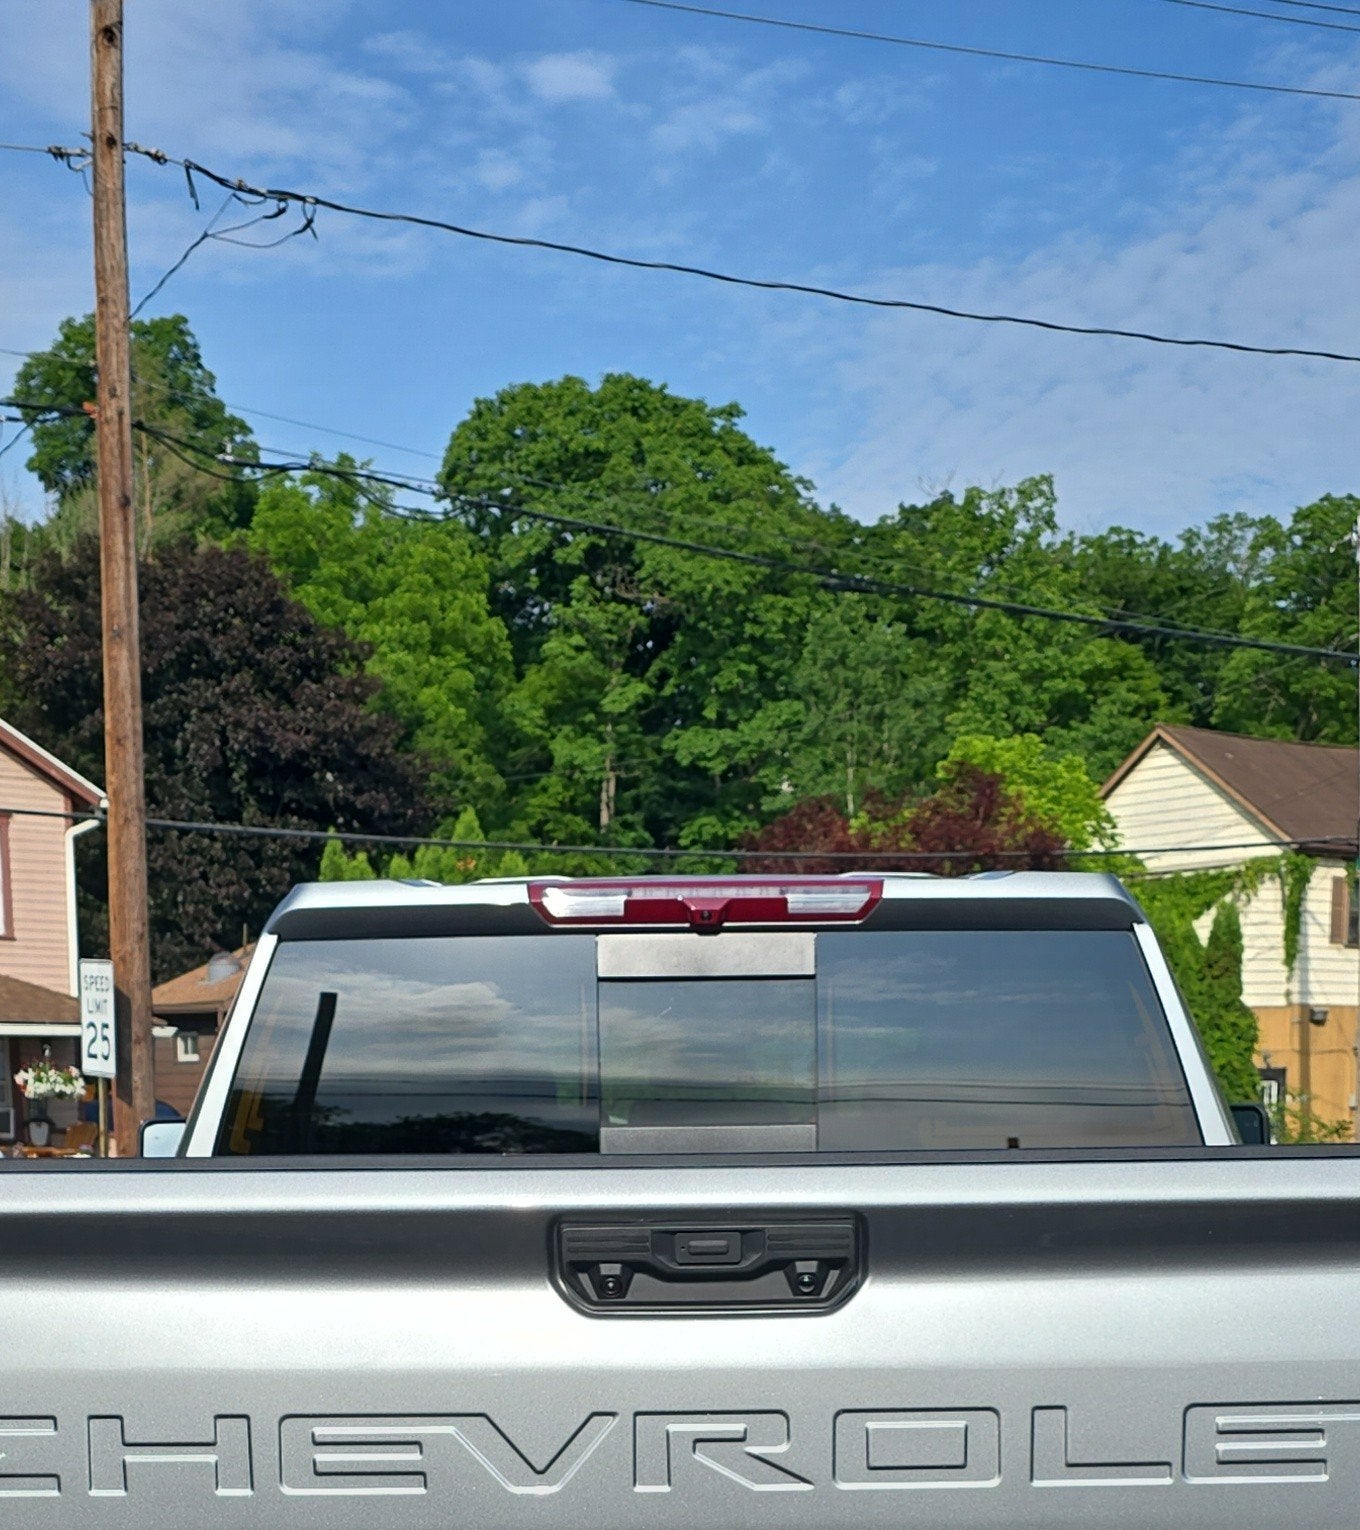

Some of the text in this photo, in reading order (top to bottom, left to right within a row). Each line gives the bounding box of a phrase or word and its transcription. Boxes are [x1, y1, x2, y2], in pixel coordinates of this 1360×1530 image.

[83, 974, 110, 993] SPEED
[86, 998, 109, 1014] LIMIT
[86, 1021, 111, 1061] 25
